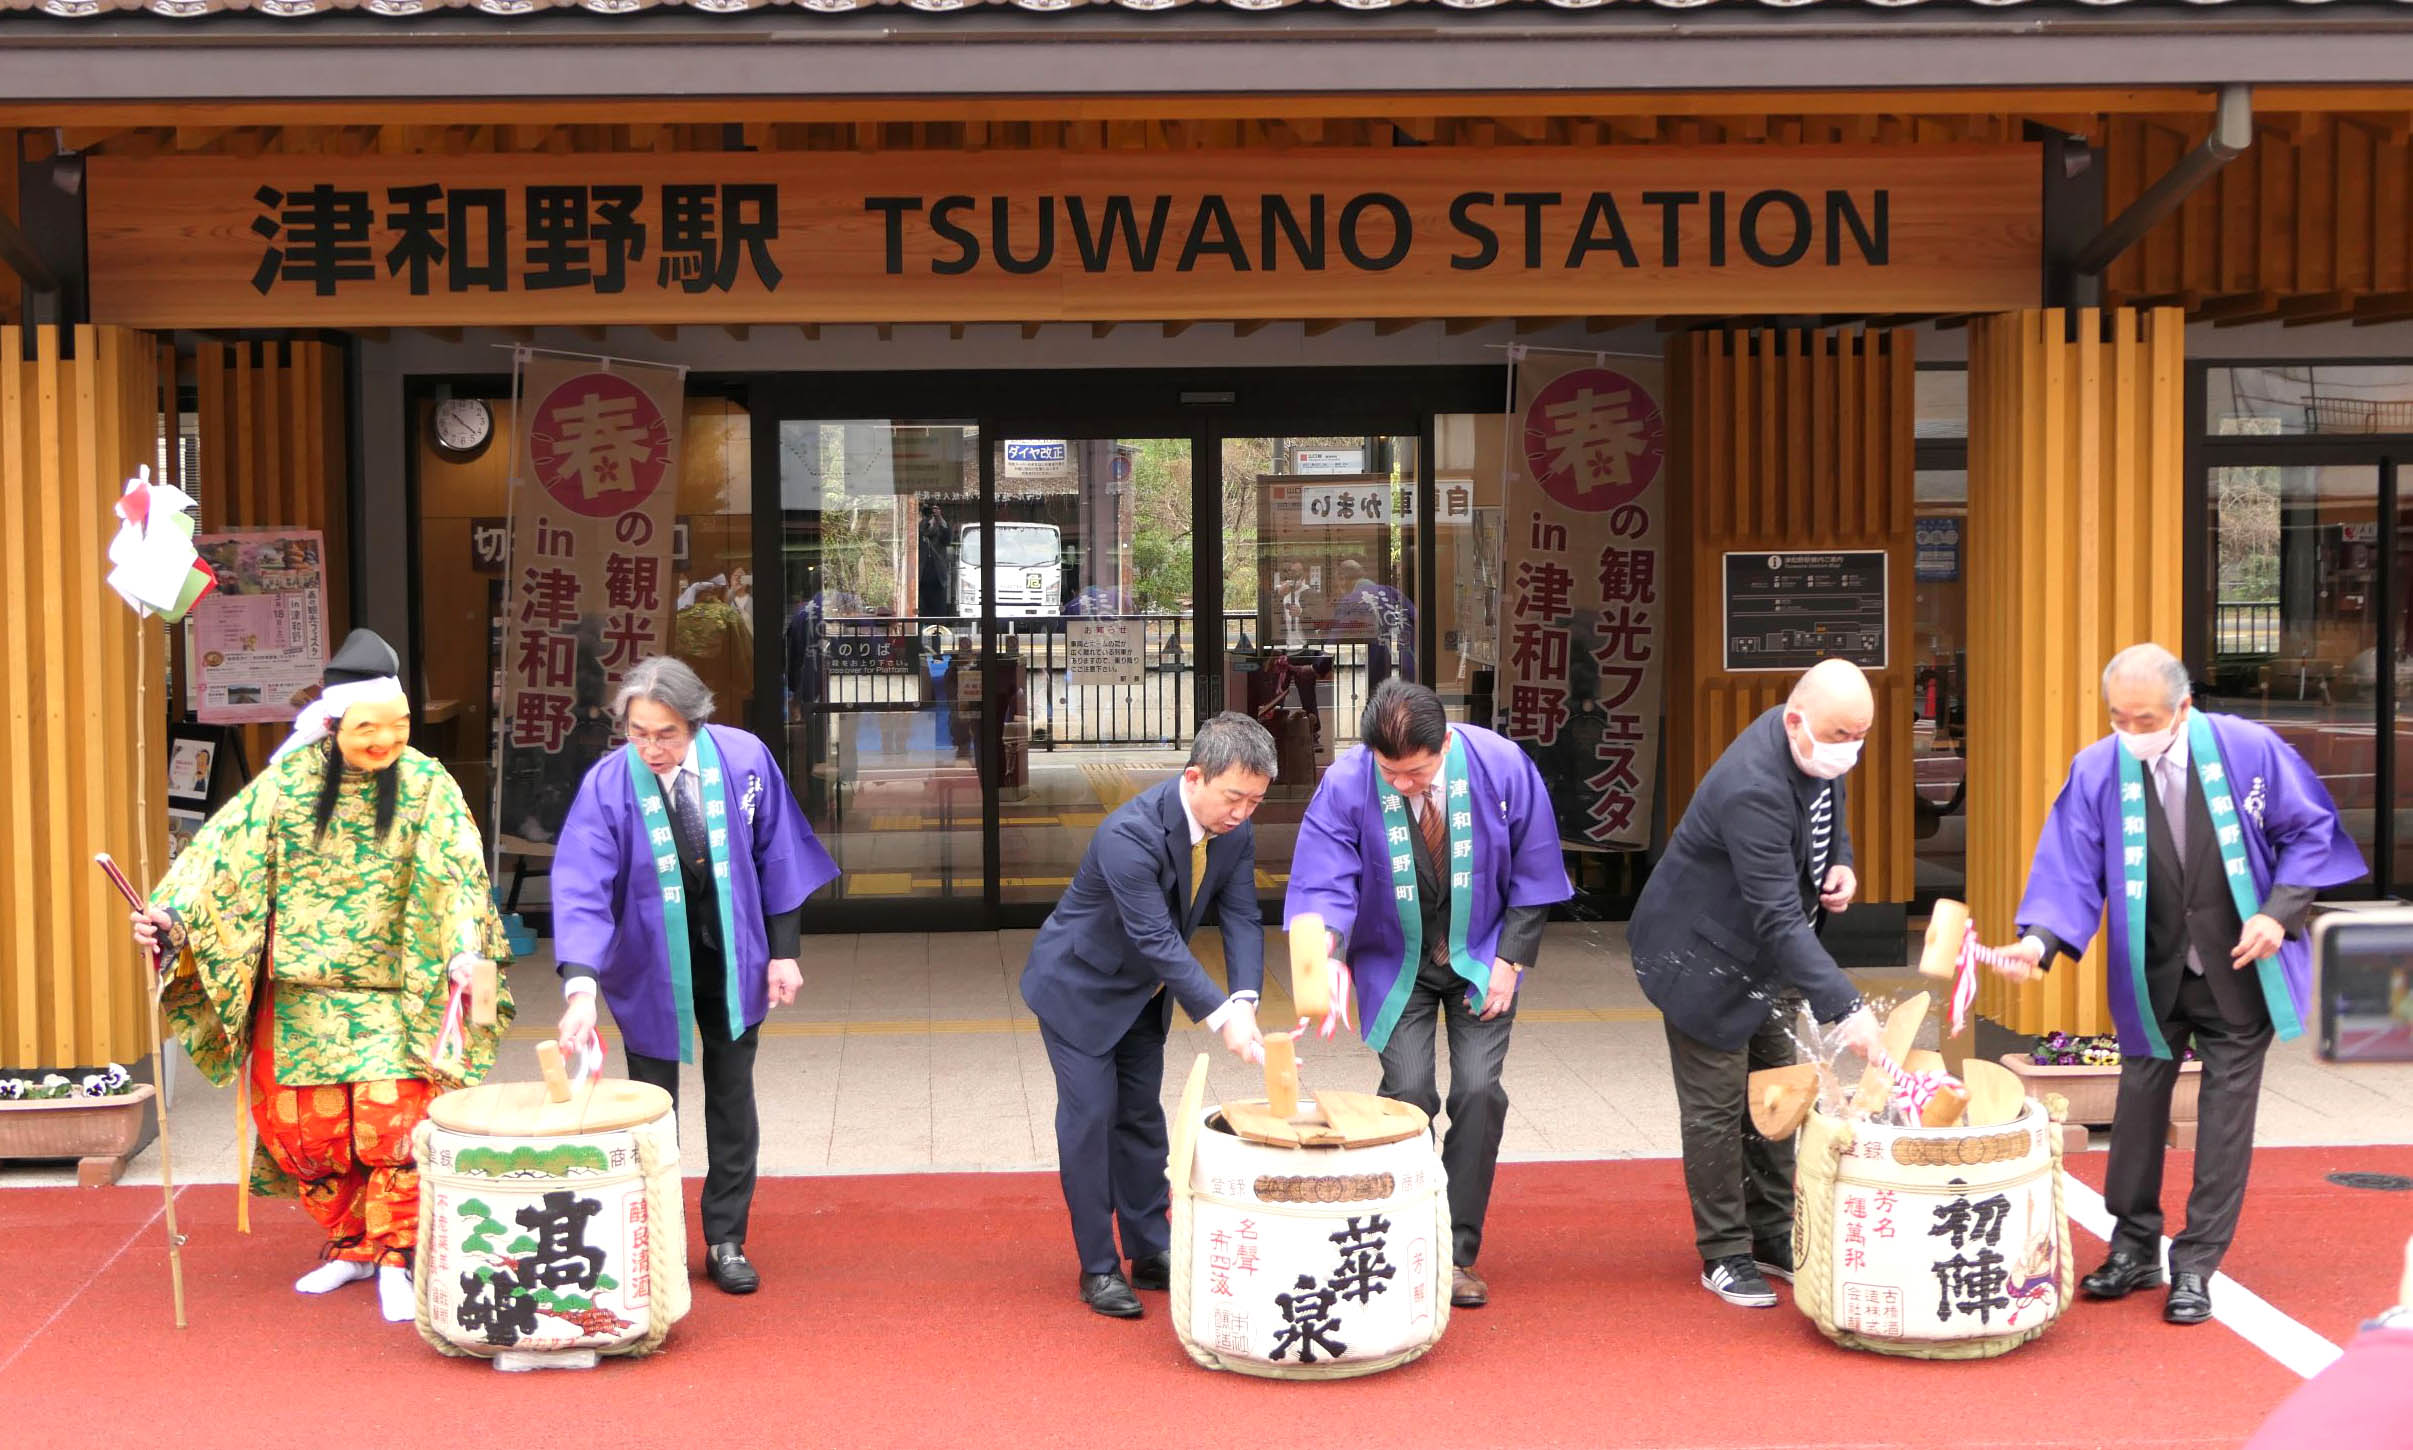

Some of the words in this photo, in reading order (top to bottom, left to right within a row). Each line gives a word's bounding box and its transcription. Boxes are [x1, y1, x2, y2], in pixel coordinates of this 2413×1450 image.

[250, 184, 784, 296] 津和野駅
[864, 192, 1412, 275] TSUWANO
[1449, 189, 1889, 270] STATION
[552, 393, 656, 500] 春
[1008, 445, 1065, 460] ダイヤ改正
[1543, 388, 1647, 495] 春
[537, 517, 575, 558] in
[1530, 511, 1568, 553] in
[512, 567, 582, 755] 津和野
[1509, 561, 1574, 746] 津和野
[1587, 504, 1656, 843] の観光フェスタ
[641, 795, 682, 903] 津和野町
[1382, 793, 1415, 901] 津和野町
[1450, 778, 1472, 889] 津和野町
